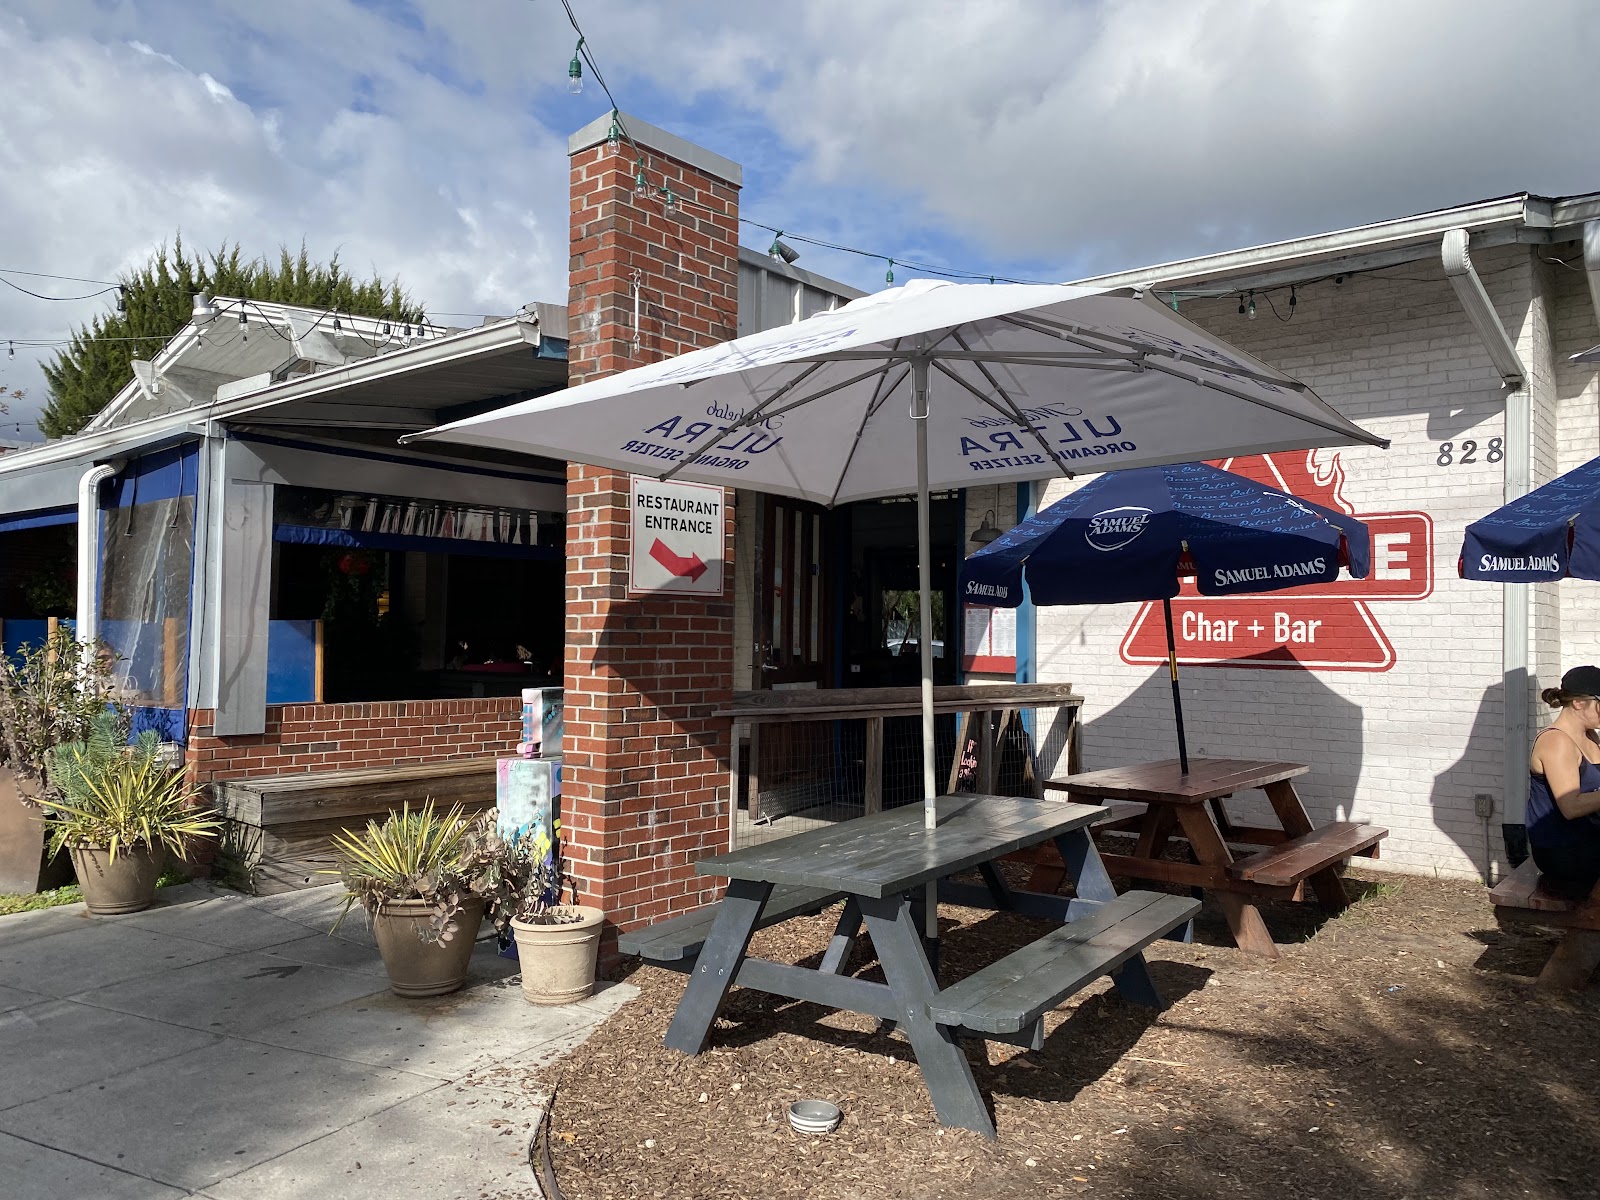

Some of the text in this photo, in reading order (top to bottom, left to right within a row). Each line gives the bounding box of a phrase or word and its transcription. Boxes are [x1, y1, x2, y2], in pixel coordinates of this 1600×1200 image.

[1437, 437, 1503, 467] 828
[1200, 481, 1239, 492] Patrio
[637, 494, 719, 516] RESTAURANT
[1251, 503, 1292, 517] Patrio
[645, 515, 712, 534] ENTRANCE
[1088, 512, 1150, 528] SAMUEL
[1089, 523, 1142, 536] ADAMS
[1215, 558, 1326, 587] SAMUEL ADAMS
[1478, 553, 1560, 573] SAMUEL ADAMS
[965, 580, 995, 596] SAMUEL
[1182, 611, 1322, 643] Char + Bar
